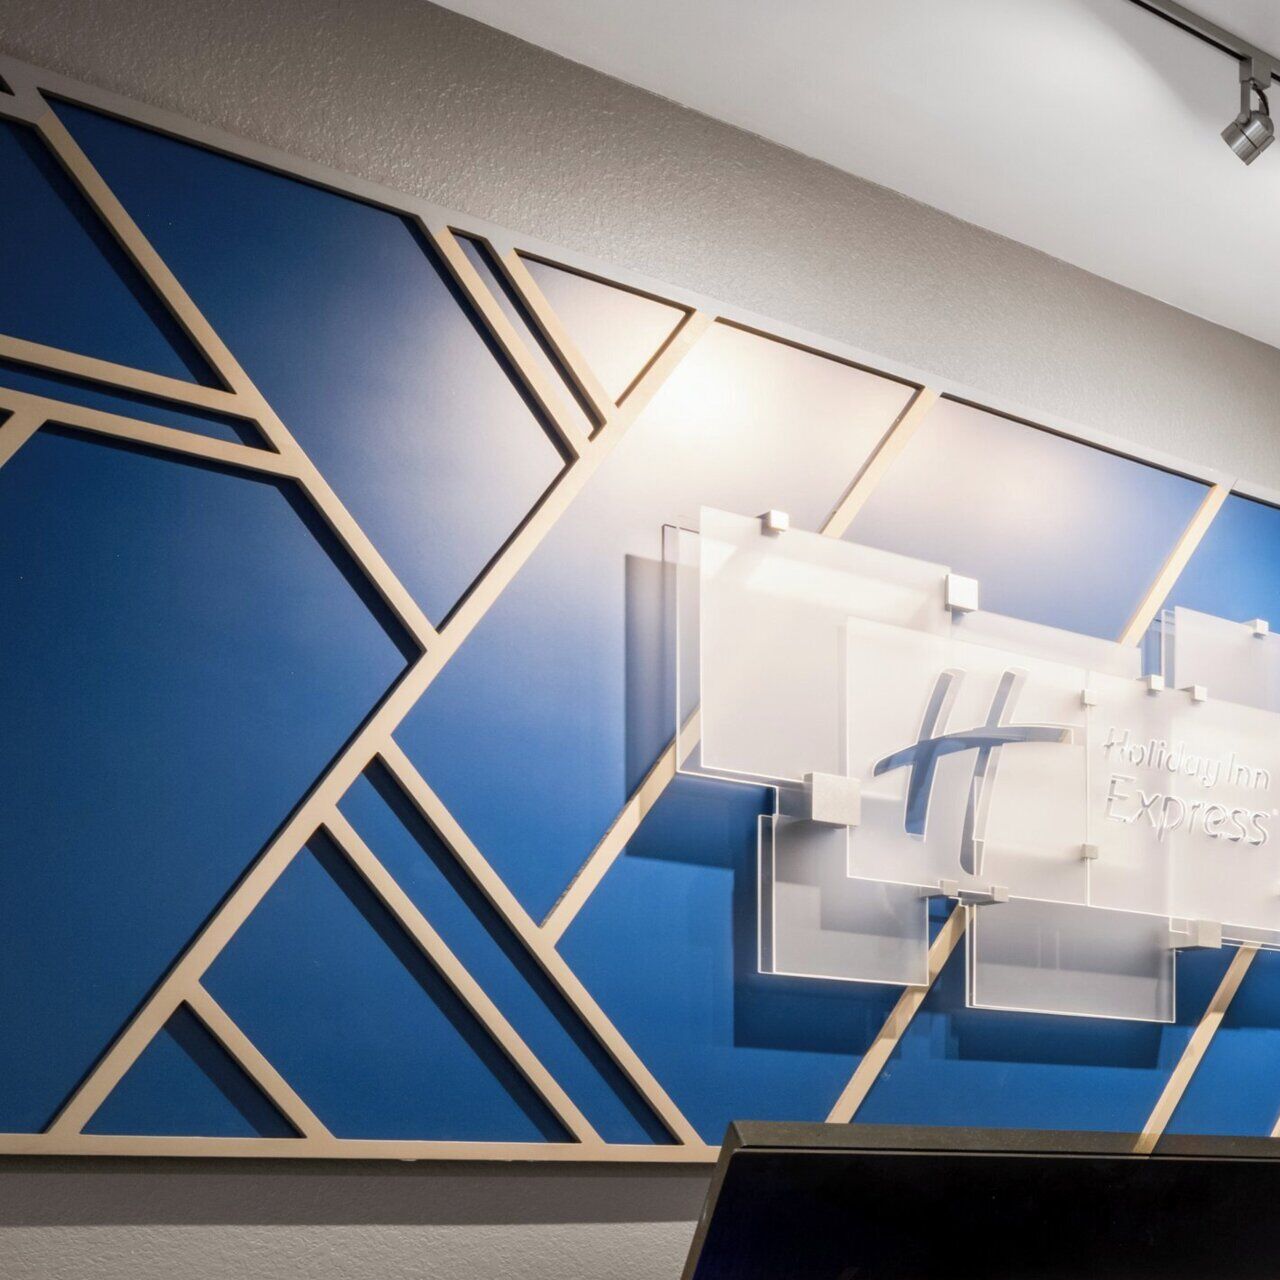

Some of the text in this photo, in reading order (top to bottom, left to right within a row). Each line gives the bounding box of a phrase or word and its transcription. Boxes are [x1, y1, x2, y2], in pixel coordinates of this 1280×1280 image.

[1103, 727, 1271, 790] Holiday Inn
[1105, 774, 1271, 847] Express
